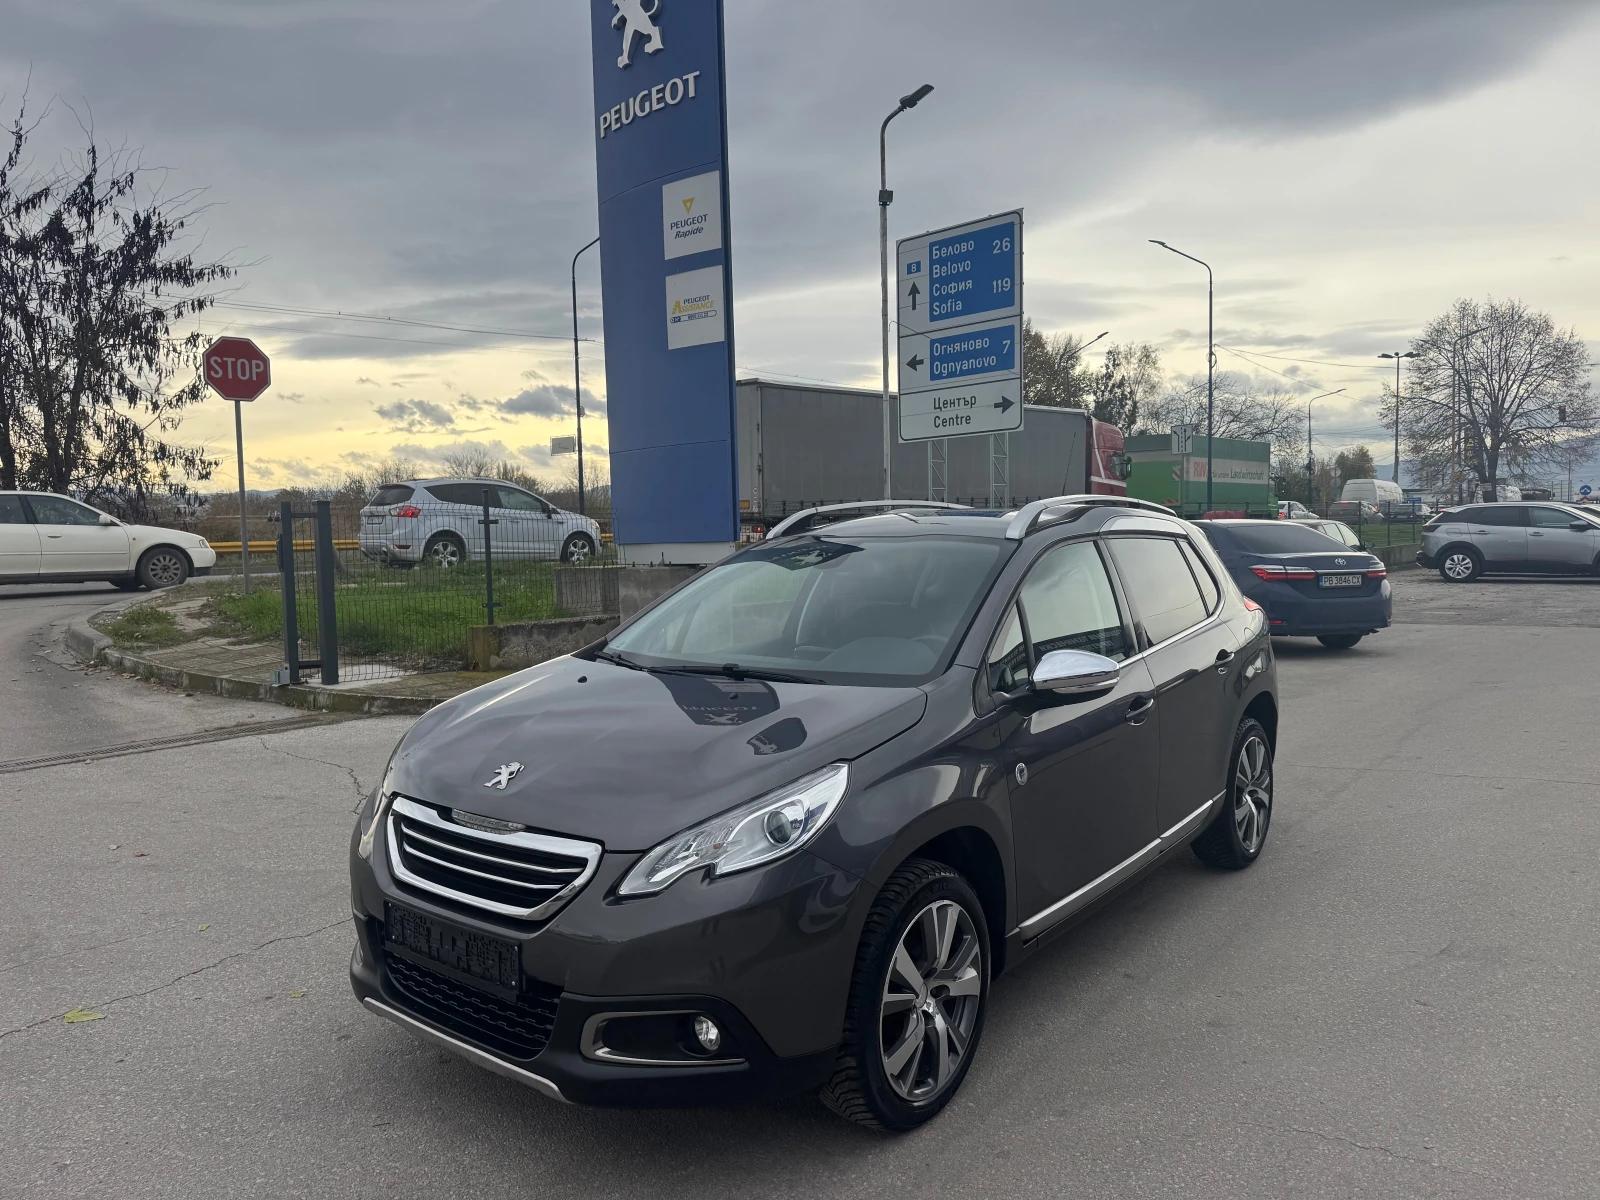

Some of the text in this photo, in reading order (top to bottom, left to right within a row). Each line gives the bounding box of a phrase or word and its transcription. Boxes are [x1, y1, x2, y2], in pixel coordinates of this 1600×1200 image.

[599, 70, 701, 139] PEUGEOT
[670, 213, 708, 230] PEUGEOT
[675, 226, 704, 239] Rapide
[932, 238, 1011, 260] Белово 26
[911, 263, 917, 273] 8
[932, 260, 971, 278] Belovo
[933, 277, 1011, 297] София 119
[683, 294, 710, 305] PEUGEOT
[933, 299, 962, 315] Sofia
[933, 337, 1011, 356] Огняново 7
[209, 355, 265, 381] STOP
[933, 355, 997, 377] Ognyanovo
[933, 395, 977, 412] Център
[933, 413, 972, 428] Centre
[1193, 461, 1209, 478] RW
[1323, 575, 1361, 585] PB 3846 CX
